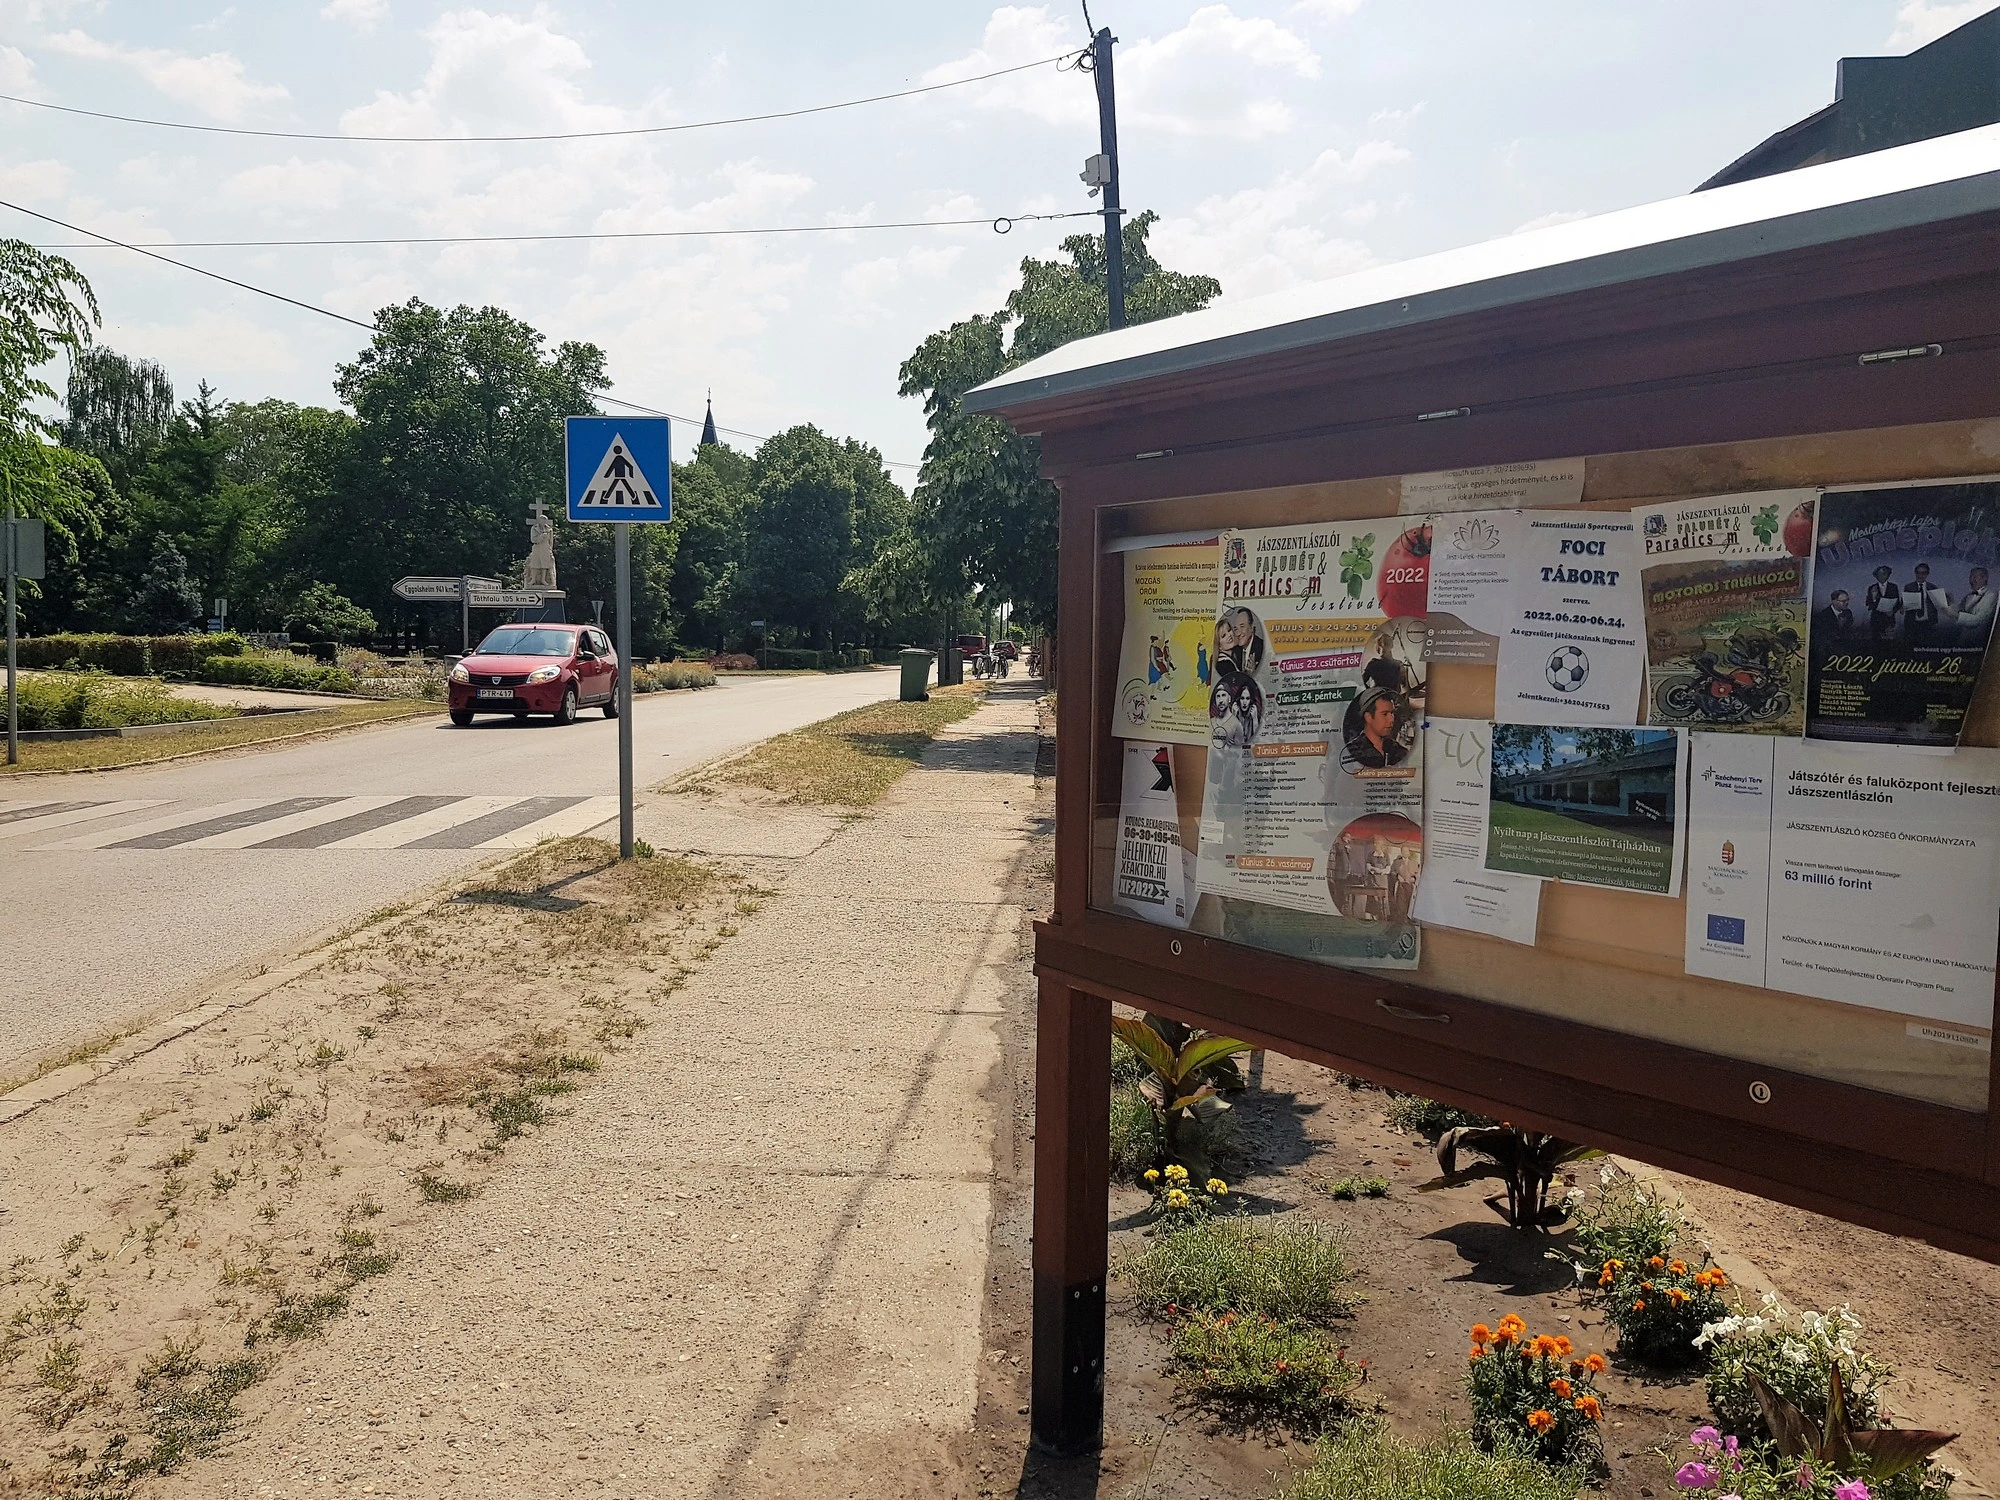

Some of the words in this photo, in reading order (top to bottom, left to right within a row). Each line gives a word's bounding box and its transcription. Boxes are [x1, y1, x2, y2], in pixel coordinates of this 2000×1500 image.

[1470, 468, 1485, 476] utca
[1470, 478, 1500, 489] egységes
[1550, 474, 1559, 482] és
[1676, 504, 1750, 522] JÁSZSZENTLÁSZLÓI
[1530, 520, 1586, 530] Jászszentlászlói
[1677, 518, 1730, 535] FALUHÉT
[1732, 516, 1741, 532] &
[1848, 516, 1909, 541] Mesterházi
[1909, 514, 1940, 528] Lajos
[1257, 530, 1341, 552] JÁSZSZENTLÁSZLÓI
[1559, 539, 1607, 556] FOCI
[1256, 551, 1316, 573] FALUHÉT
[1317, 552, 1328, 575] &
[1135, 577, 1161, 585] MOZGÁS
[1386, 567, 1425, 584] 2022
[1541, 563, 1620, 587] TÁBORT
[404, 584, 435, 594] Eggolsheim
[435, 584, 445, 593] 941
[1139, 586, 1158, 595] ÖRÖM
[1653, 581, 1720, 603] MOTOROS
[1723, 569, 1796, 591] TALÁLKOZÓ
[473, 594, 500, 603] Tóthfalu
[1143, 598, 1175, 606] AGYTORNA
[1295, 587, 1384, 612] Fesztivál
[1562, 596, 1591, 605] szervez.
[1523, 610, 1625, 628] 2022.06.20-06.24.
[1510, 627, 1520, 635] Az
[1521, 628, 1553, 639] egyesület
[1554, 631, 1601, 643] játékosainak
[1602, 636, 1636, 646] ingyenes!
[1281, 660, 1304, 672] Június
[1306, 656, 1361, 669] 23.csütörtök
[1821, 655, 1874, 673] 2022.
[1871, 657, 1934, 682] június
[1935, 656, 1963, 675] 26.
[481, 689, 513, 699] PTR-417
[1277, 693, 1300, 704] Június
[1302, 690, 1343, 704] 24.péntek
[1256, 746, 1278, 755] Június
[1714, 773, 1748, 784] Széchenyi
[1748, 776, 1763, 784] Terv
[1714, 780, 1732, 789] Plusz
[1788, 769, 1845, 784] Játszótér
[1847, 775, 1863, 786] és
[1866, 775, 1944, 792] faluközpont
[1788, 785, 1894, 804] Jászszentlászlón
[1493, 825, 1515, 838] Nyílt
[1515, 829, 1533, 840] nap
[1539, 831, 1610, 848] Jászszentlászlói
[1610, 838, 1662, 854] Tájházban
[1786, 821, 1861, 836] JÁSZSZENTLÁSZLÓ
[1862, 828, 1897, 840] KÖZSÉG
[1898, 832, 1976, 847] ÖNKORMÁNYZATA
[1121, 840, 1168, 866] JELENTKEZZ!
[1120, 860, 1167, 880] XFAKTOR.HU
[1240, 857, 1264, 867] Június
[1265, 858, 1312, 871] 26.vasárnap
[1785, 859, 1803, 867] Vissza
[1843, 865, 1875, 876] támogatás
[1119, 877, 1155, 897] XF2022
[1784, 870, 1799, 881] 63
[1802, 872, 1835, 886] millió
[1838, 875, 1873, 890] forint
[1781, 935, 1818, 946] KÖSZÖNJÜK
[1823, 941, 1850, 951] MAGYAR
[1850, 945, 1882, 956] KORMÁNY
[1902, 952, 1931, 963] EURÓPAI
[1932, 956, 1950, 966] UNIÓ
[1814, 963, 1875, 980] Településfejlesztési
[1876, 973, 1905, 985] Operatív
[1905, 978, 1935, 990] Program
[1935, 983, 1955, 993] Plusz
